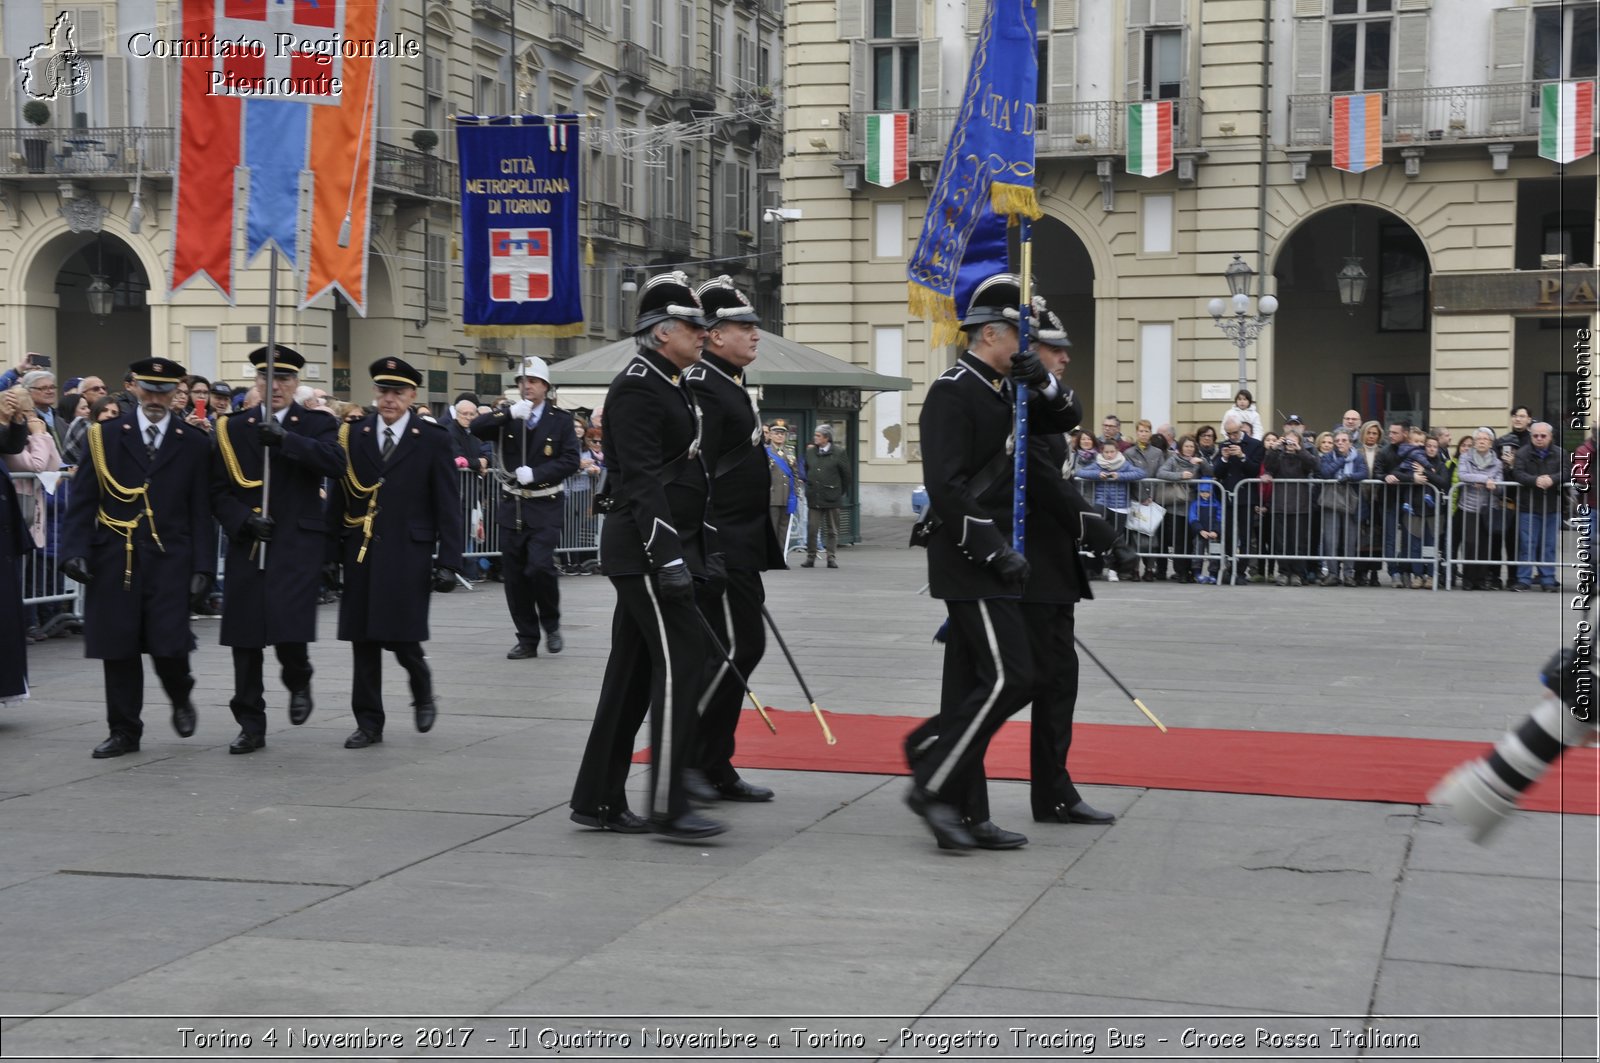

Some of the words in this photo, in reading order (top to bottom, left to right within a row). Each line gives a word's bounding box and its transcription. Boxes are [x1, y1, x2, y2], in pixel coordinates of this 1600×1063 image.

[500, 156, 536, 174] CITTÀ
[466, 178, 570, 194] METROPOLITANA
[488, 199, 501, 214] DI
[504, 199, 551, 214] TORINO
